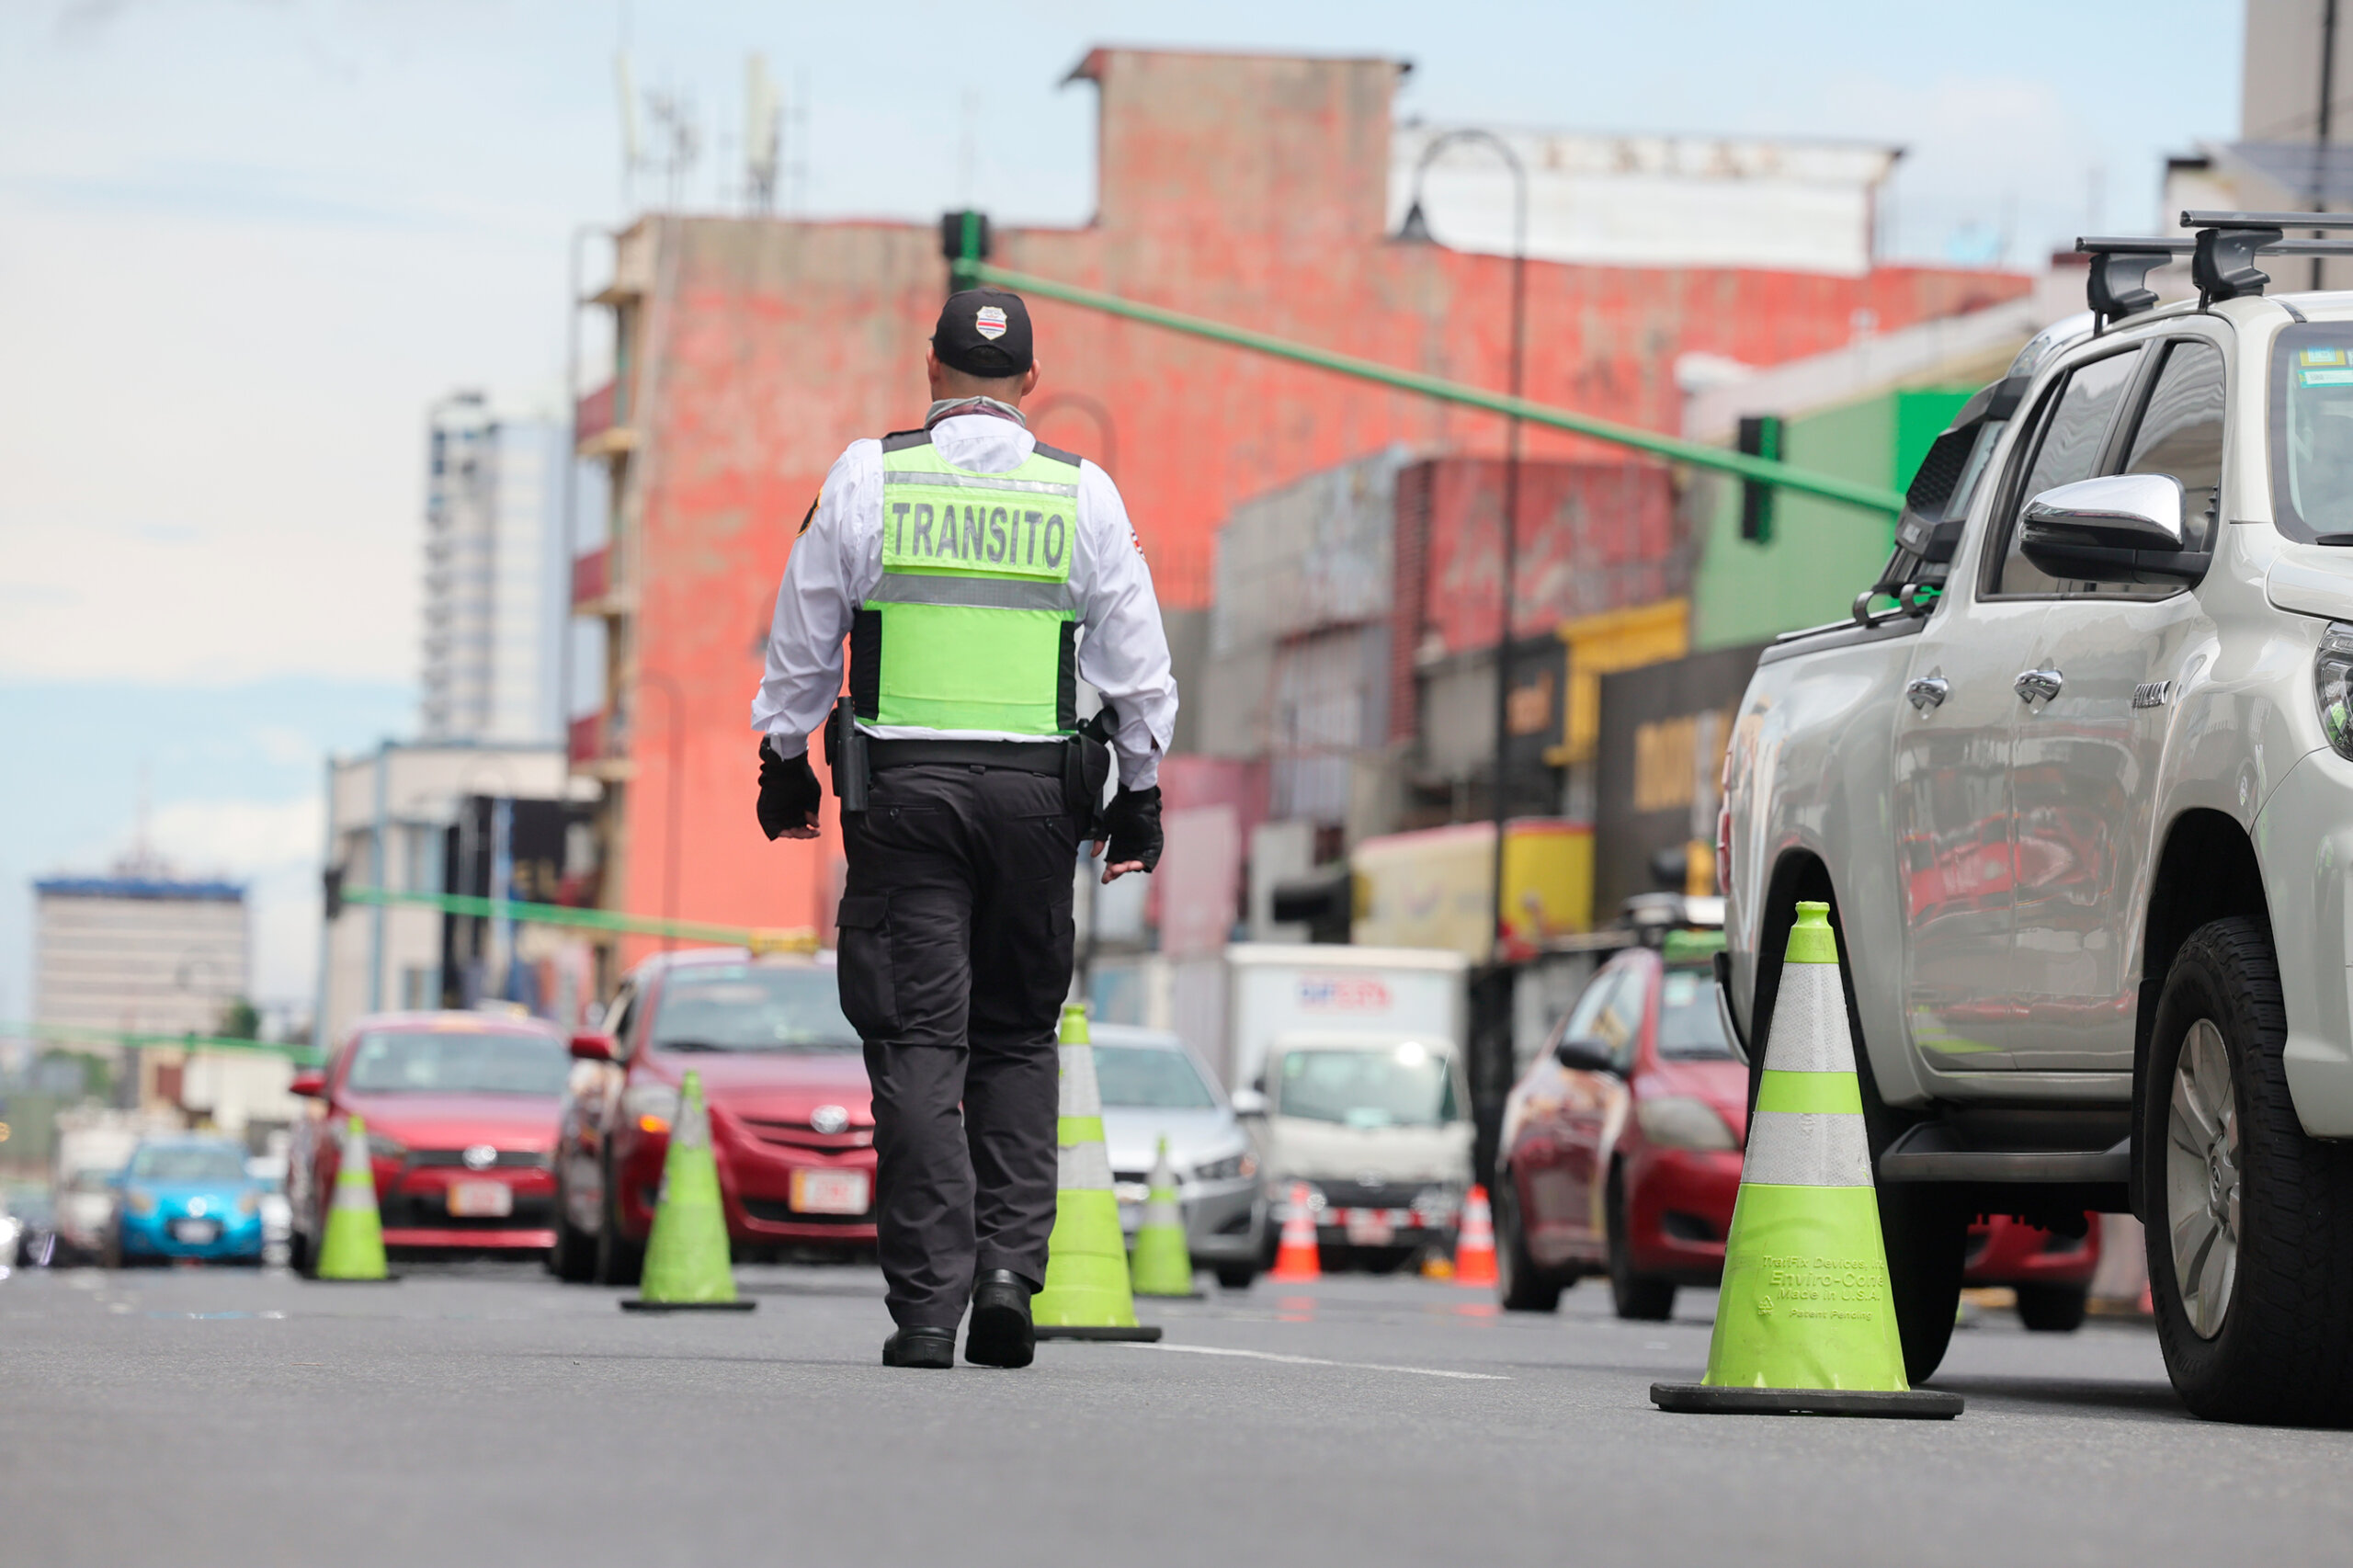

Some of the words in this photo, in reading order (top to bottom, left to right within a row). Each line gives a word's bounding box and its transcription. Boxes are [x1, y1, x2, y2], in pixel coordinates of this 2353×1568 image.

[892, 503, 1065, 569] TRANSITO
[1813, 1256, 1868, 1270] Devices,
[1769, 1270, 1883, 1287] Enviro-Cone
[1777, 1288, 1819, 1301] Made
[1824, 1289, 1836, 1301] in
[1841, 1289, 1881, 1301] U.S.A.
[1789, 1309, 1827, 1319] Patent
[1830, 1310, 1873, 1322] Pending
